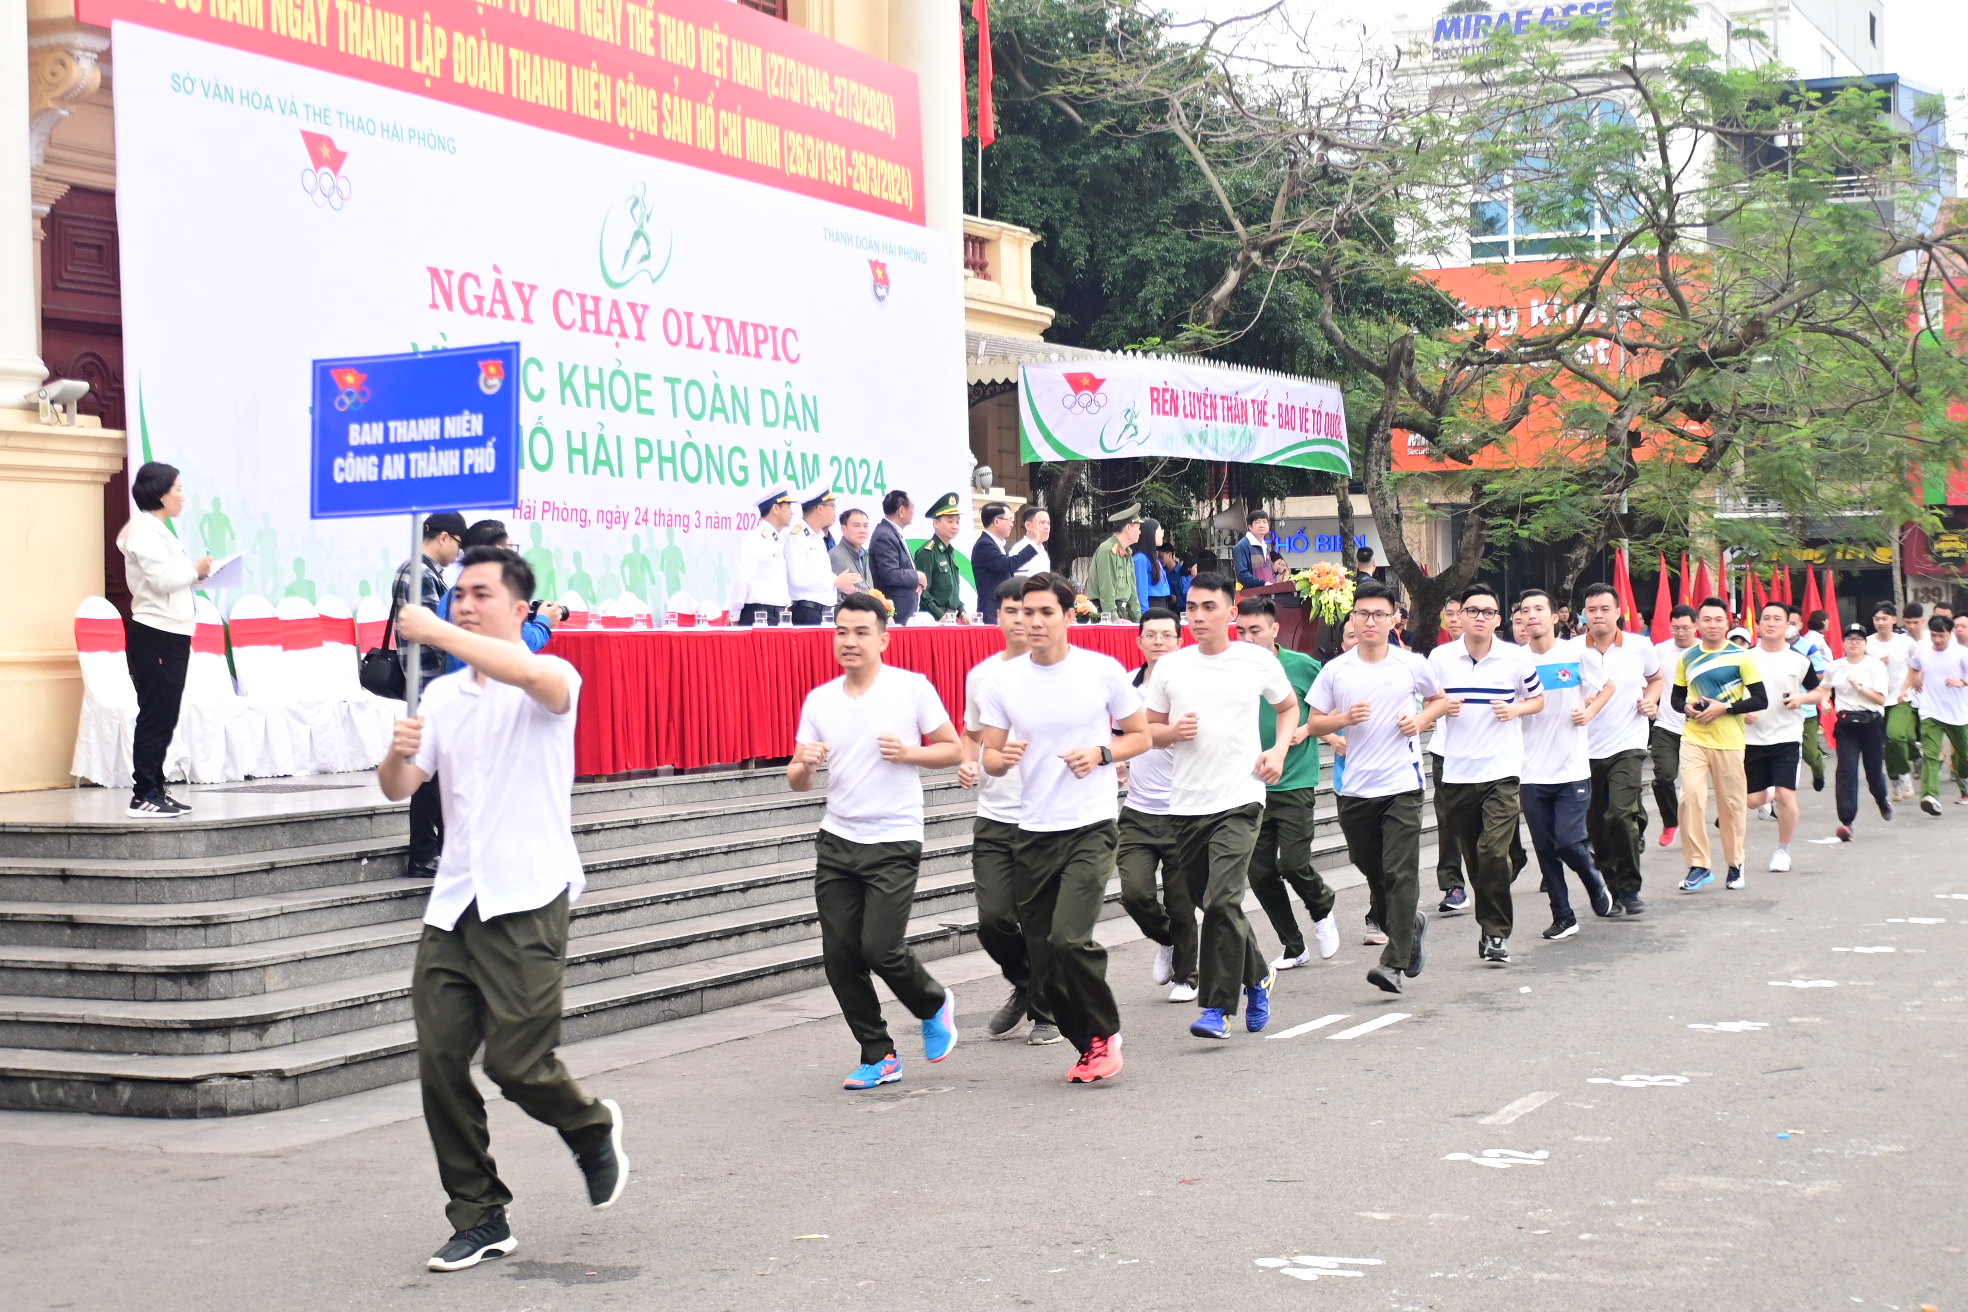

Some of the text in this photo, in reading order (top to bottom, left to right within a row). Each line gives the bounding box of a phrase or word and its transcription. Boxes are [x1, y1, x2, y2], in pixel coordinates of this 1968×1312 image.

[1434, 9, 1533, 42] MIRAE
[335, 0, 404, 68] THÀNH
[410, 11, 447, 88] LẬP
[453, 27, 504, 95] ĐOÀN
[509, 47, 566, 112] THANH
[572, 60, 612, 124] NIÊN
[616, 72, 658, 140] CỘNG
[662, 75, 692, 146] SẢN
[696, 90, 715, 152] HỒ
[719, 105, 742, 159] CHÍ
[745, 117, 780, 170] MINH
[784, 129, 913, 212] (26/3/1931-26/3/2024)
[659, 13, 696, 70] THAO
[699, 22, 728, 88] VIỆT
[732, 38, 763, 91] NAM
[766, 51, 896, 140] (27/3/1946-27/3/2024)
[171, 71, 196, 96] SỞ
[200, 77, 234, 105] VĂN
[240, 85, 274, 114] HÓA
[278, 94, 299, 120] VÀ
[337, 111, 377, 136] THAO
[381, 118, 404, 142] HẢI
[409, 127, 457, 155] PHÒNG
[426, 263, 801, 364] NGÀY CHẠY OLYMPIC
[557, 358, 655, 417] KHỎE
[663, 370, 752, 427] TOÀN
[760, 380, 820, 434] DÂN
[1150, 381, 1179, 418] RÈN
[1182, 386, 1217, 429] LUYỆN
[1220, 391, 1249, 426] THÂN
[1251, 388, 1269, 428] THỂ
[1277, 391, 1296, 432] BẢO
[1298, 401, 1310, 441] VỆ
[1311, 399, 1323, 437] TỔ
[348, 410, 484, 446] BAN THANH NIÊN
[333, 452, 379, 483] CÔNG
[381, 454, 405, 480] AN
[408, 446, 460, 479] THÀNH
[463, 436, 497, 474] PHỐ
[566, 421, 624, 479] HẢI
[634, 430, 750, 488] PHÒNG
[759, 439, 821, 491] NĂM
[828, 455, 887, 497] 2024
[512, 498, 537, 522] Hải
[541, 500, 591, 529] Phòng,
[597, 505, 629, 531] ngày
[634, 506, 649, 527] 24
[654, 507, 690, 534] tháng
[695, 510, 701, 530] 3
[705, 510, 732, 531] năm
[1315, 534, 1367, 553] BIN
[1911, 586, 1943, 603] 139
